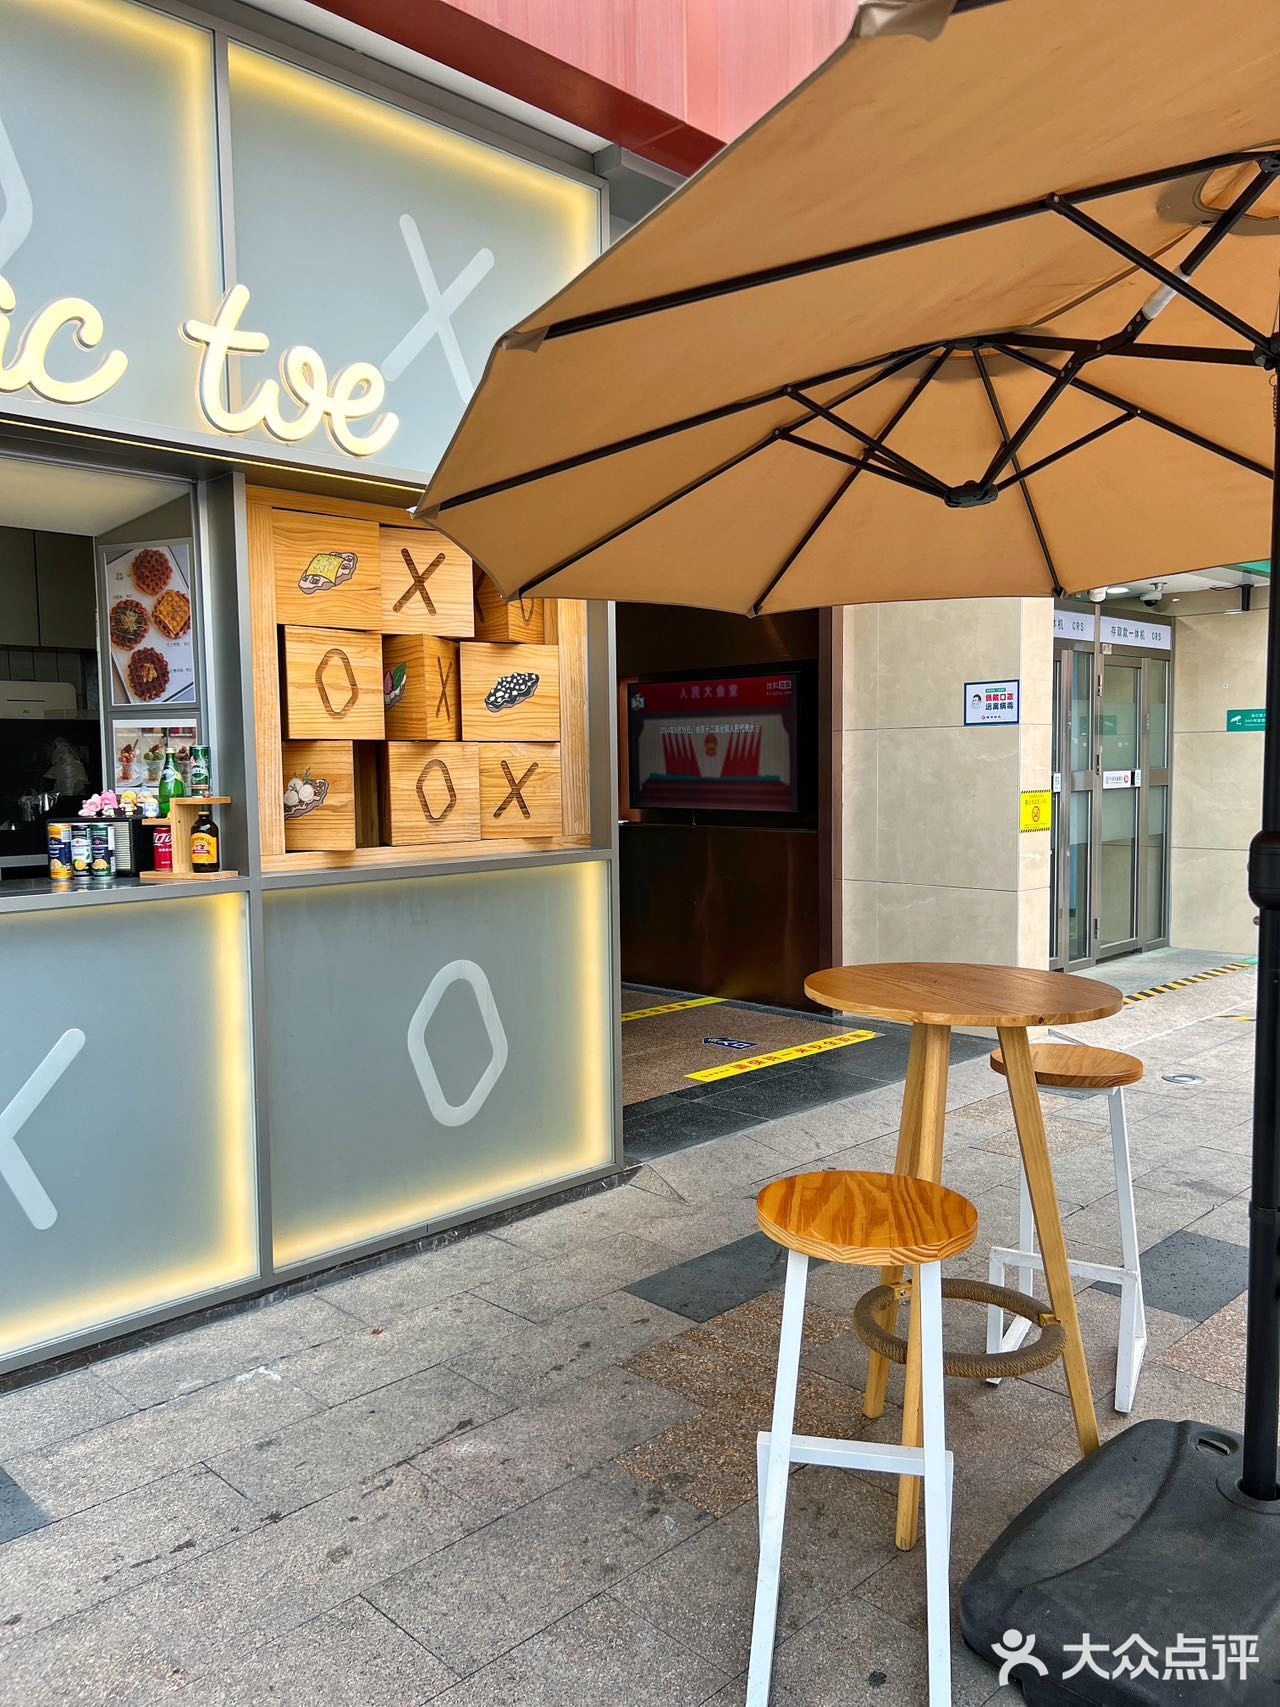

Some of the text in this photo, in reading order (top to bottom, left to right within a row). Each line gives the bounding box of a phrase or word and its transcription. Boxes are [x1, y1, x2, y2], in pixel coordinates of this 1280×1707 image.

[1110, 625, 1146, 641] 存取款一体机
[985, 702, 1014, 711] 远离病毒
